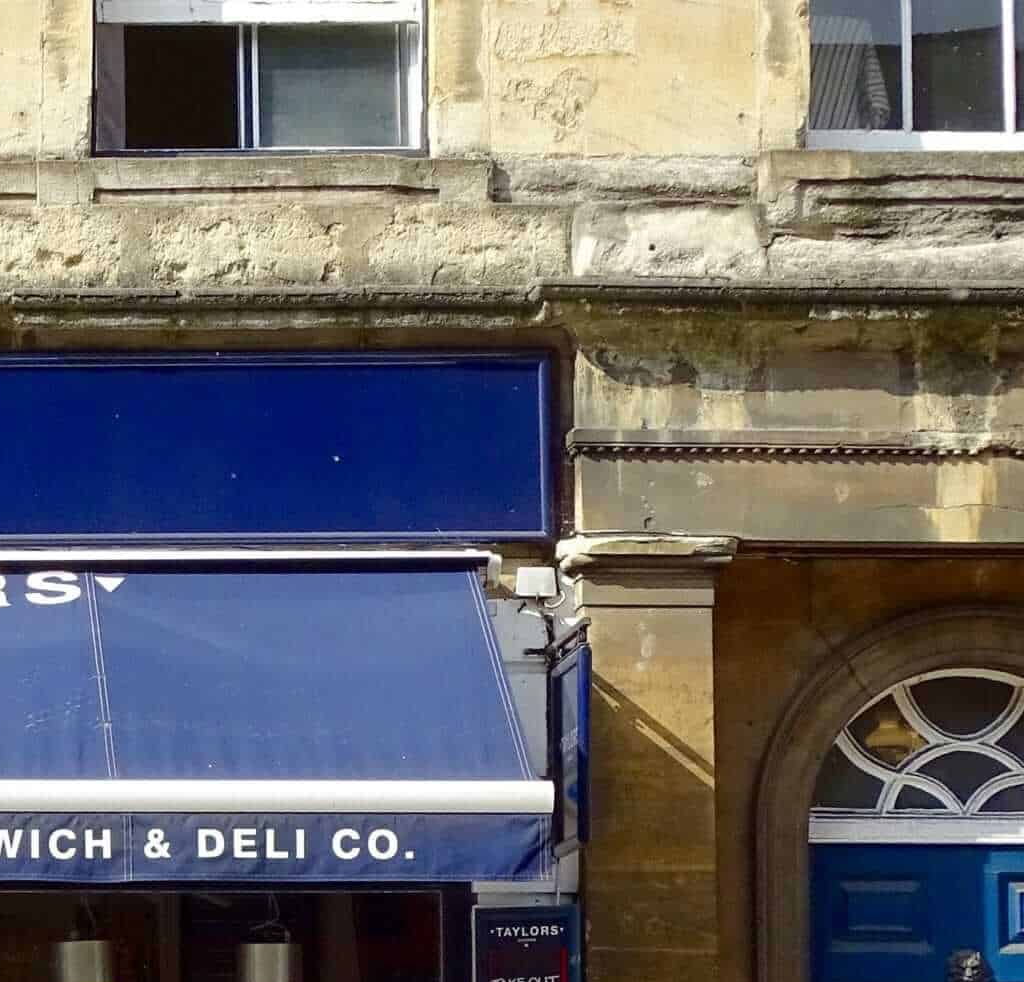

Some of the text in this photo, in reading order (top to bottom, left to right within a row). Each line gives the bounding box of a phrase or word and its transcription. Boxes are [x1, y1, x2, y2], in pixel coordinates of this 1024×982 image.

[143, 828, 171, 860] &
[197, 828, 305, 860] DELI
[332, 828, 414, 860] CO.
[495, 925, 559, 937] TAYLORS
